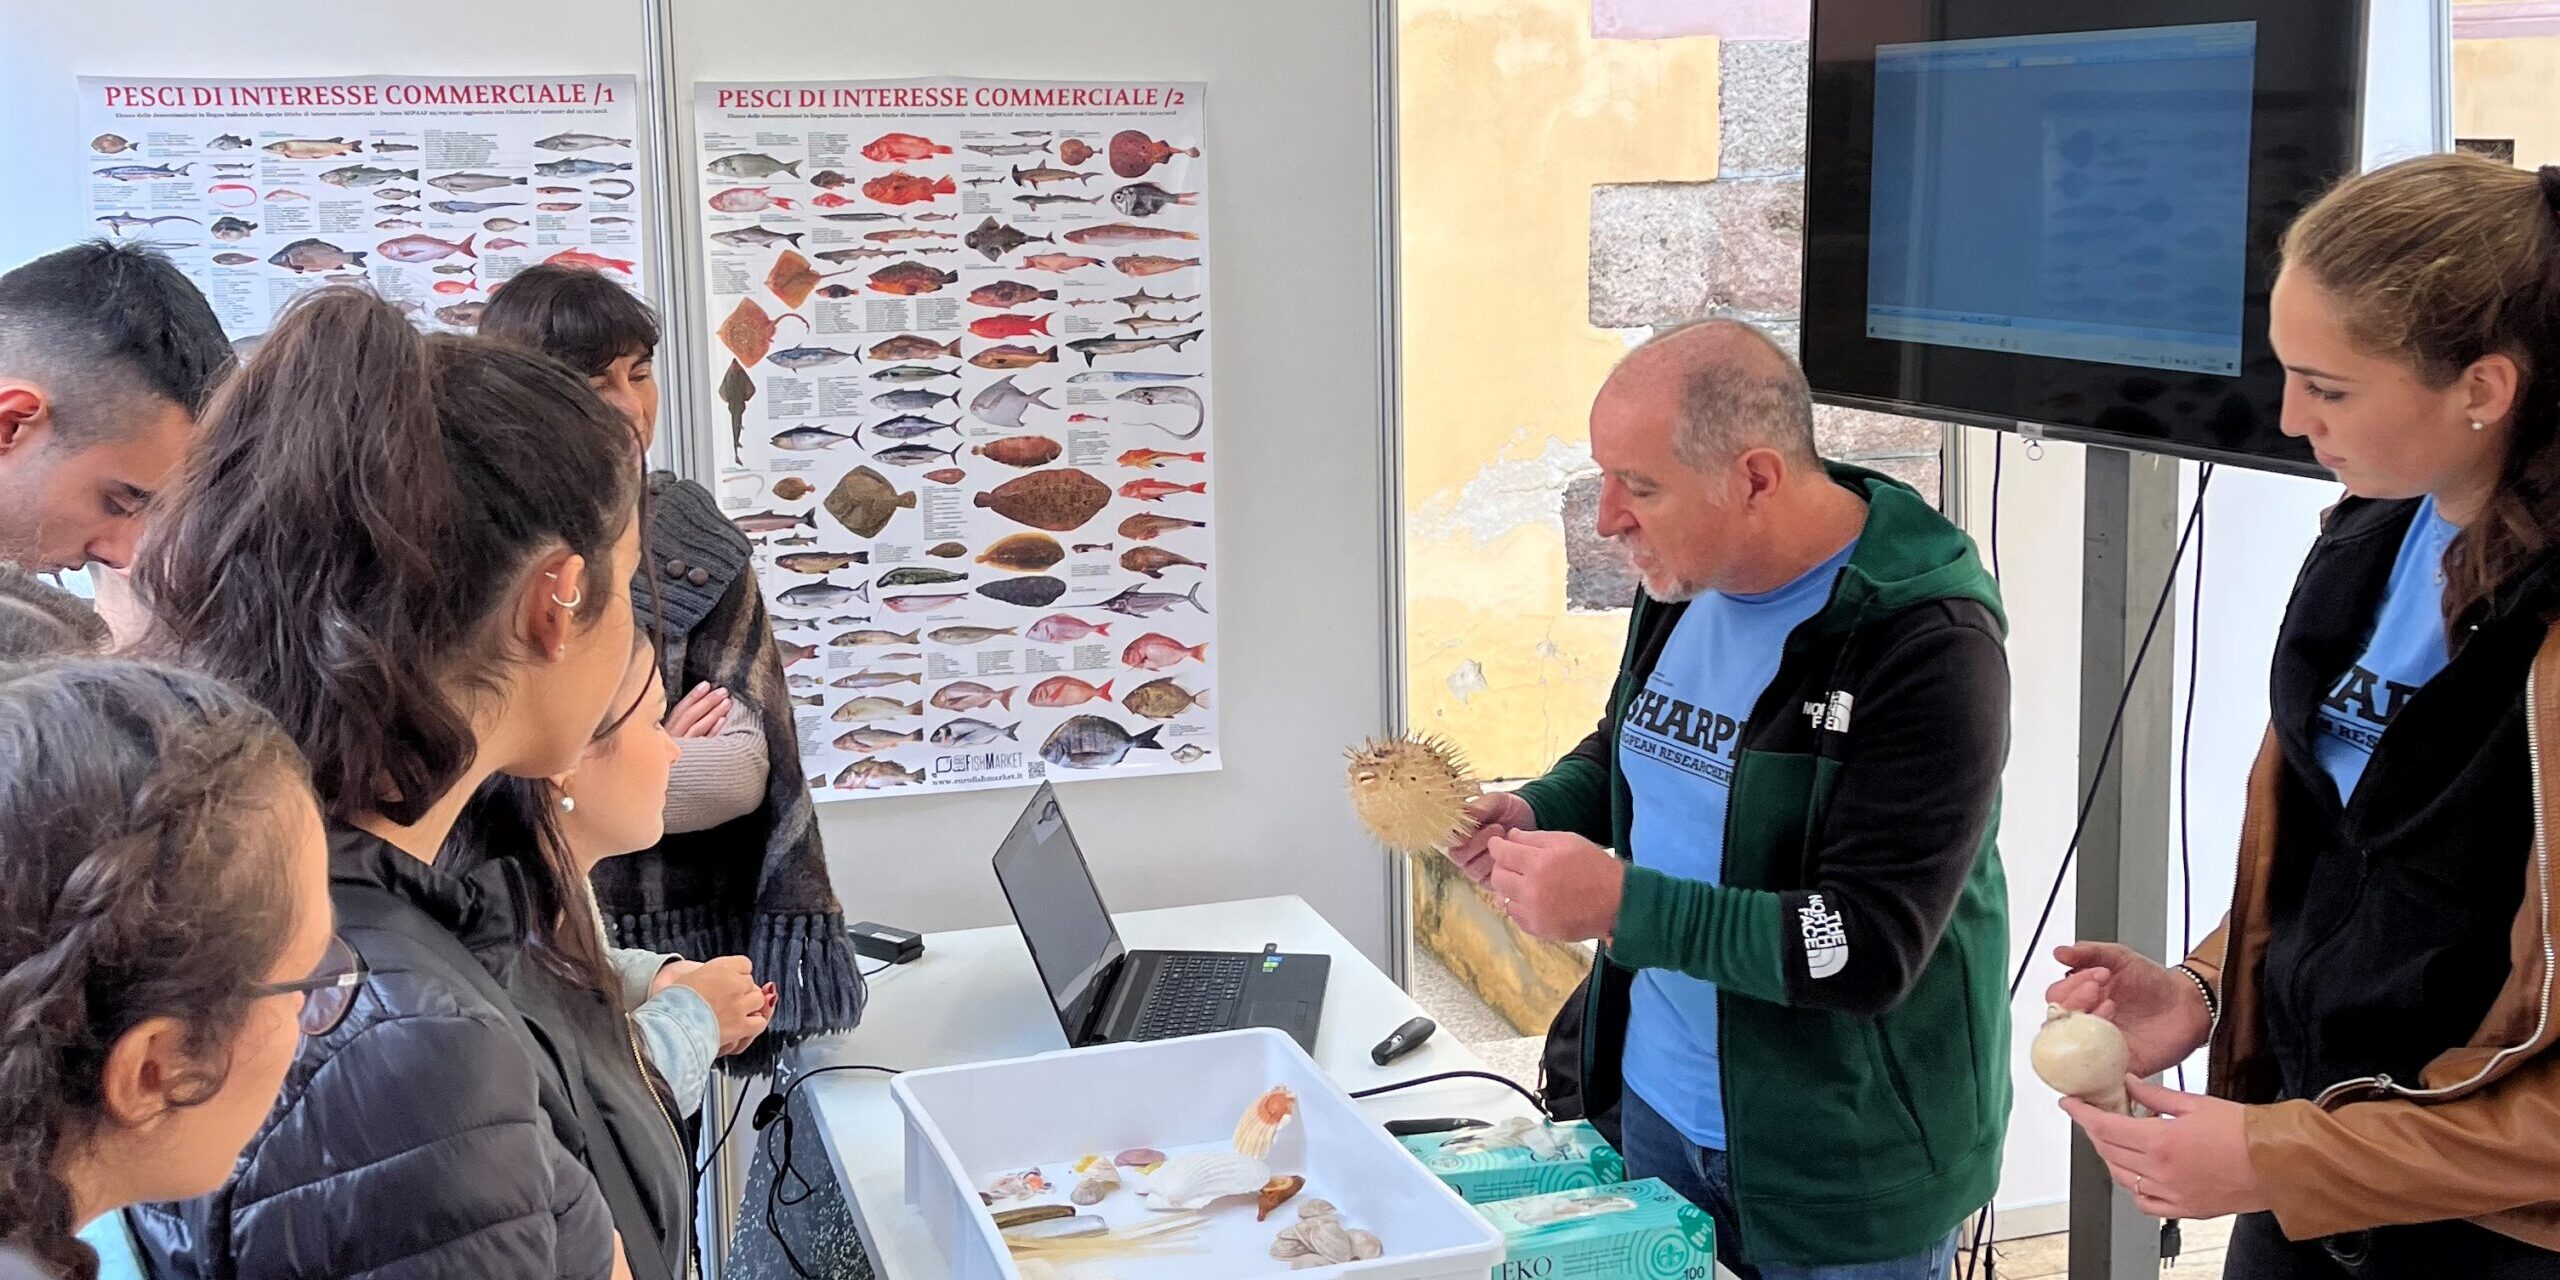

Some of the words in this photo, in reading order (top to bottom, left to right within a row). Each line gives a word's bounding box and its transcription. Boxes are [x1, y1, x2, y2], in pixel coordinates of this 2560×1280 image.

[104, 86, 187, 107] PESCI
[191, 86, 224, 107] DI
[229, 85, 378, 106] INTERESSE
[385, 84, 586, 104] COMMERCIALE
[593, 82, 615, 106] /1
[717, 89, 792, 108] PESCI
[798, 89, 826, 108] DI
[832, 87, 968, 107] INTERESSE
[975, 87, 1158, 106] COMMERCIALE
[1164, 88, 1185, 108] /2
[932, 772, 1023, 785] www.eurofishmarket.it
[1798, 907, 1820, 949] FACE
[1808, 894, 1837, 949] NORTH
[1825, 910, 1848, 946] THE
[1501, 1256, 1552, 1280] EKO
[1683, 1265, 1705, 1280] 100
